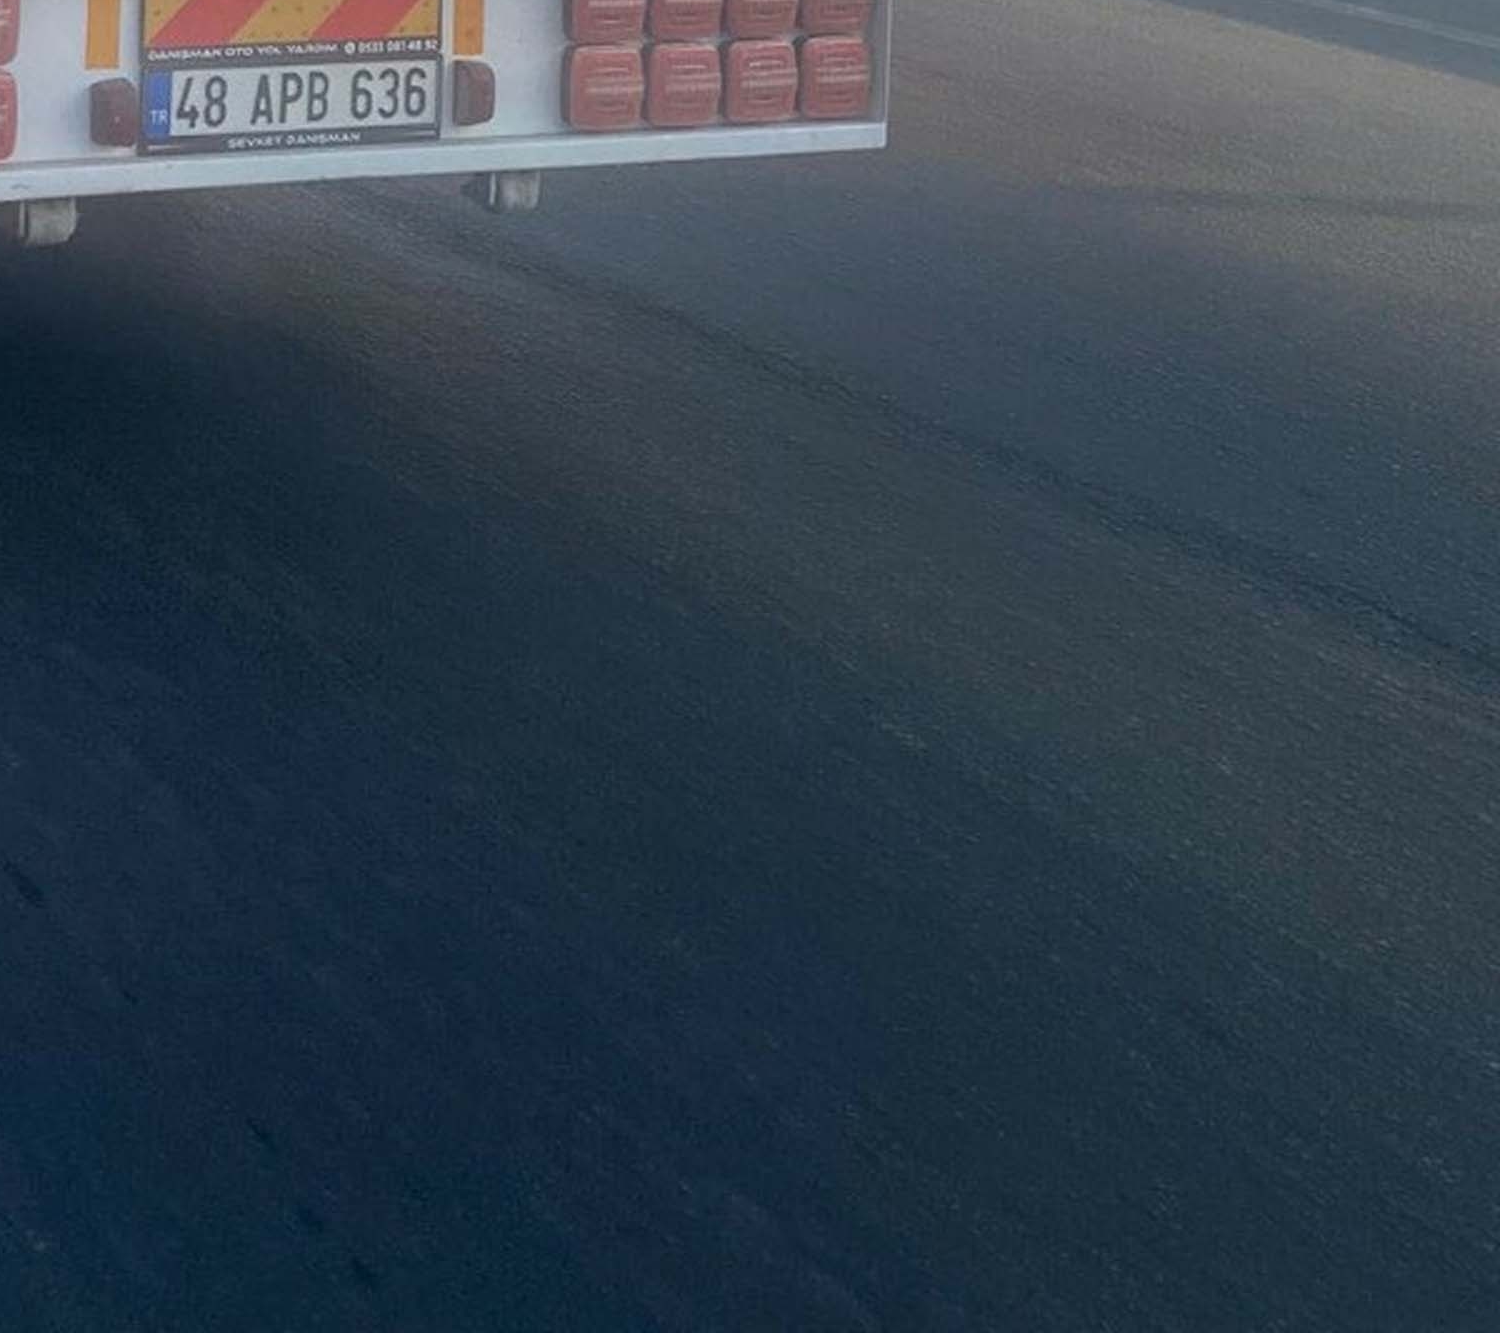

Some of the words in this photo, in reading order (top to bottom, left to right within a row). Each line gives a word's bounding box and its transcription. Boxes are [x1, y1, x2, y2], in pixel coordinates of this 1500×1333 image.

[150, 109, 168, 124] TR
[176, 75, 228, 129] 48
[250, 71, 329, 125] APB
[350, 67, 427, 120] 636
